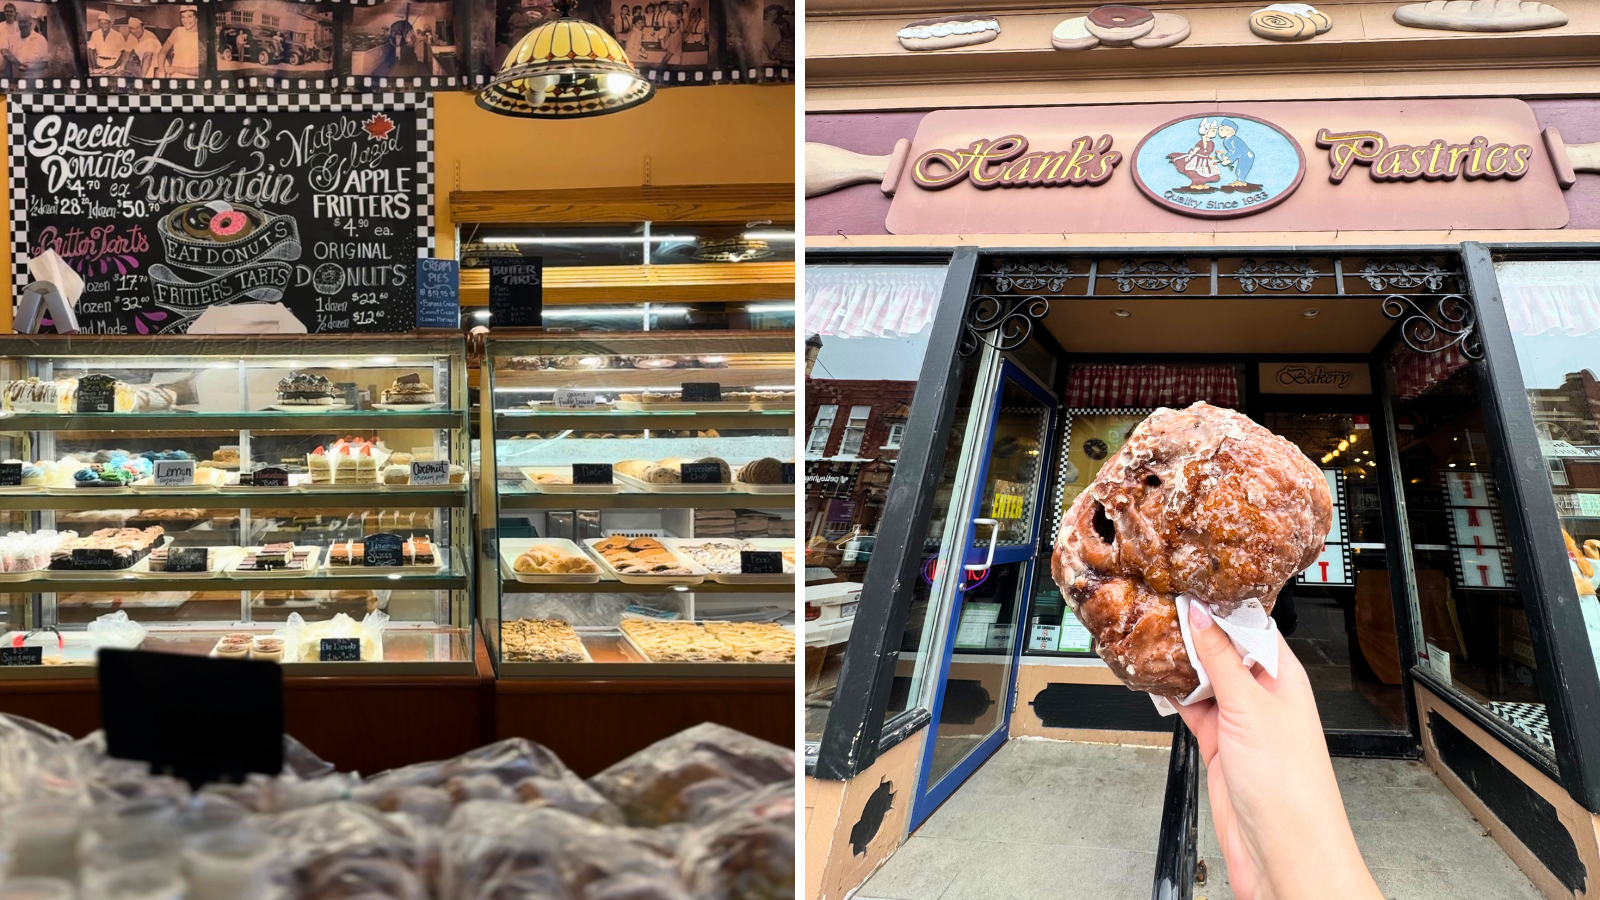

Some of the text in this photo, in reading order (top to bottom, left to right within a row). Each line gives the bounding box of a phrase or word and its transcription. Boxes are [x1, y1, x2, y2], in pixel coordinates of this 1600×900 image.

[28, 115, 135, 157] Special
[276, 116, 362, 167] Maple
[133, 117, 272, 178] Life is
[308, 124, 403, 193] Glazed
[914, 130, 1530, 187] Hank's Pastries
[67, 180, 101, 198] $4.70
[135, 151, 299, 208] uncertain
[343, 167, 411, 193] APPLE
[117, 199, 160, 218] $50.70
[313, 193, 411, 220] FRITTERS
[1163, 190, 1269, 210] Quality Since 1963
[333, 217, 394, 238] $4.90 ea.
[31, 224, 150, 262] Butter Tarts
[166, 221, 288, 265] EAT DONUTS
[313, 241, 392, 260] ORIGINAL
[422, 259, 452, 272] CREAM
[492, 264, 537, 276] BUTTER
[235, 266, 289, 290] TARTS
[427, 273, 450, 283] PIES
[501, 274, 541, 286] TARTS
[156, 279, 233, 306] FRITTERS
[324, 297, 348, 313] dozen
[351, 292, 389, 306] $22.60
[97, 317, 128, 335] Made
[352, 310, 385, 326] $12.60
[1279, 368, 1351, 389] Bakery
[157, 463, 192, 478] Lemon
[412, 461, 448, 476] Coconut
[684, 464, 718, 474] Chocolate
[991, 493, 1024, 519] ENTER
